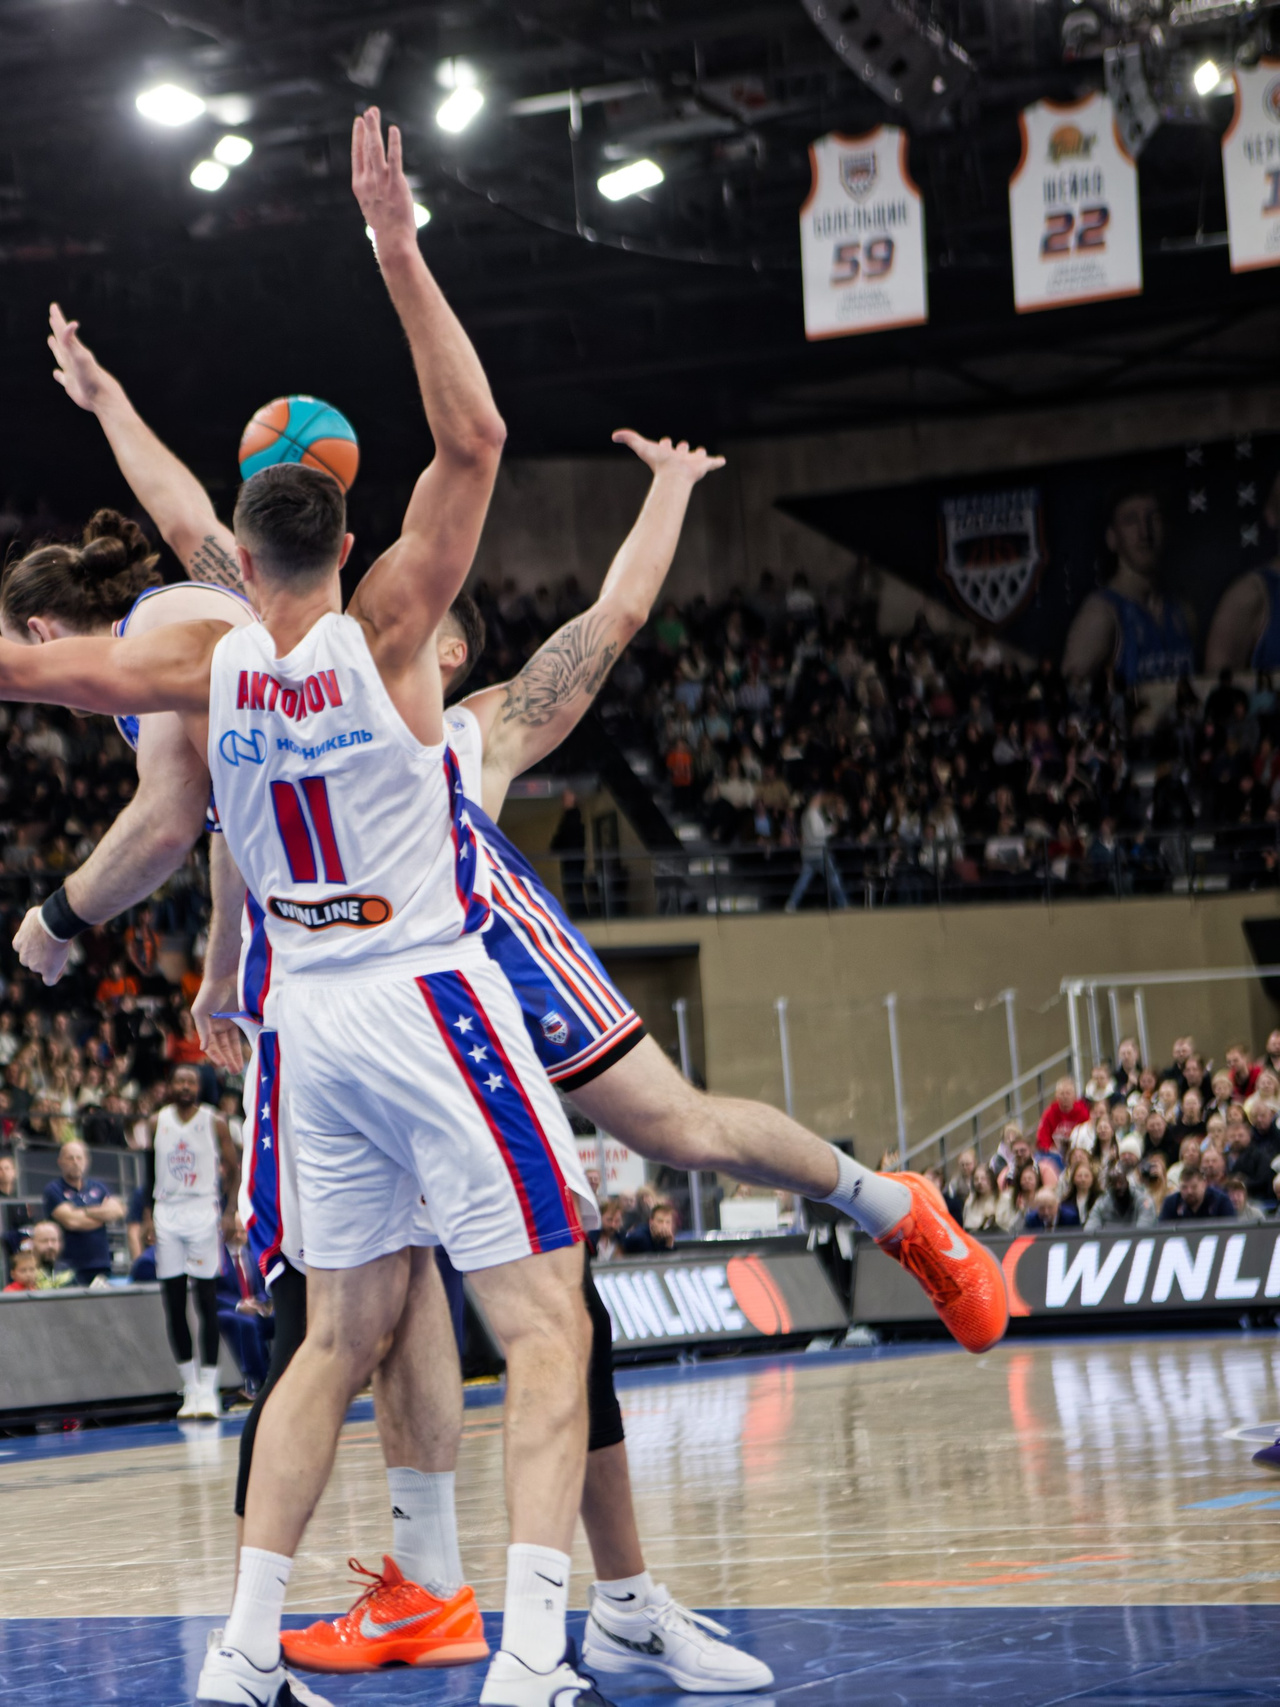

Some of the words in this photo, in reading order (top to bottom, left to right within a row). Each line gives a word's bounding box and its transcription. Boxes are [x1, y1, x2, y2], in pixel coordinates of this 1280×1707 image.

[813, 196, 909, 239] БОЛЕЛЬЩИК
[1040, 204, 1111, 263] 22
[830, 236, 895, 289] 59
[270, 776, 347, 885] 11
[276, 900, 361, 926] WINLINE
[184, 1173, 197, 1187] 17
